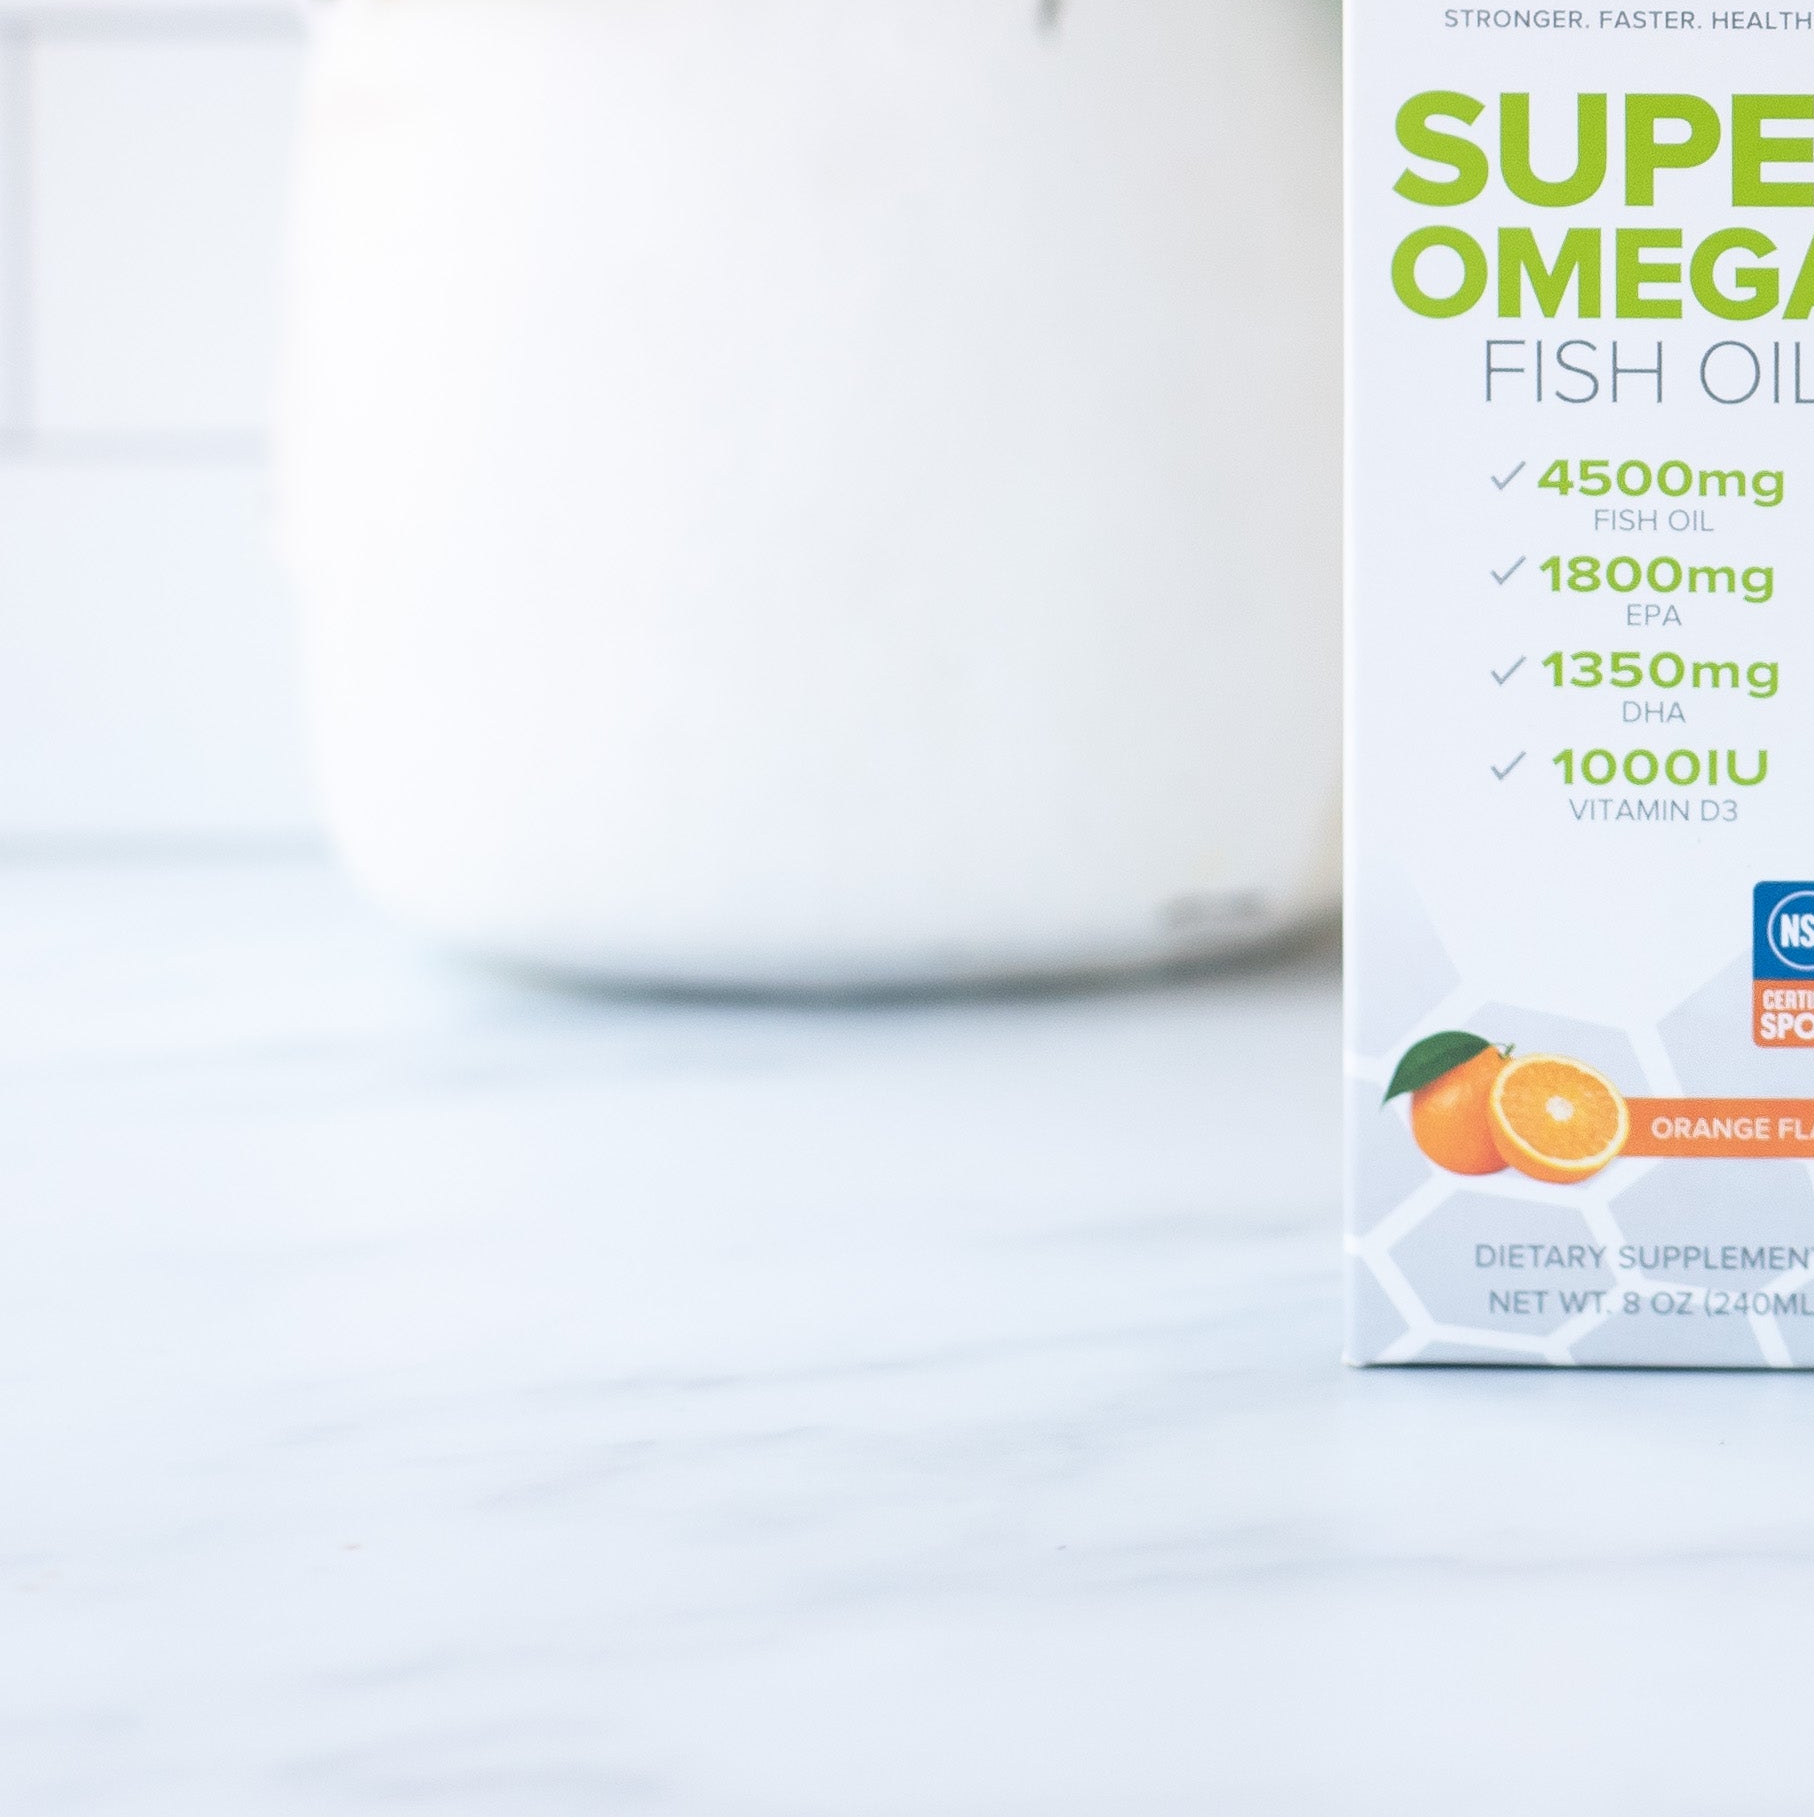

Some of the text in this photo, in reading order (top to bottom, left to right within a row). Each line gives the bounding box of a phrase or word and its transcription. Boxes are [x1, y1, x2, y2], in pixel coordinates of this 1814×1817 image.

[1444, 9, 1590, 29] STRONGER.
[1599, 10, 1703, 30] FASTER.
[1486, 339, 1663, 404] FISH
[1537, 459, 1785, 508] 4500mg
[1594, 509, 1714, 531] FISH OIL
[1539, 555, 1775, 604] 1800mg
[1626, 604, 1682, 627] EPA
[1541, 651, 1779, 699] 1350mg
[1622, 701, 1686, 724] DHA
[1552, 748, 1769, 786] 1000IU
[1569, 798, 1738, 822] VITAMIN D3
[1651, 1116, 1771, 1142] ORANGE
[1474, 1243, 1606, 1270] DIETARY
[1489, 1291, 1548, 1315] NET
[1558, 1291, 1612, 1315] WT.
[1624, 1291, 1640, 1315] 8
[1651, 1291, 1694, 1315] OZ
